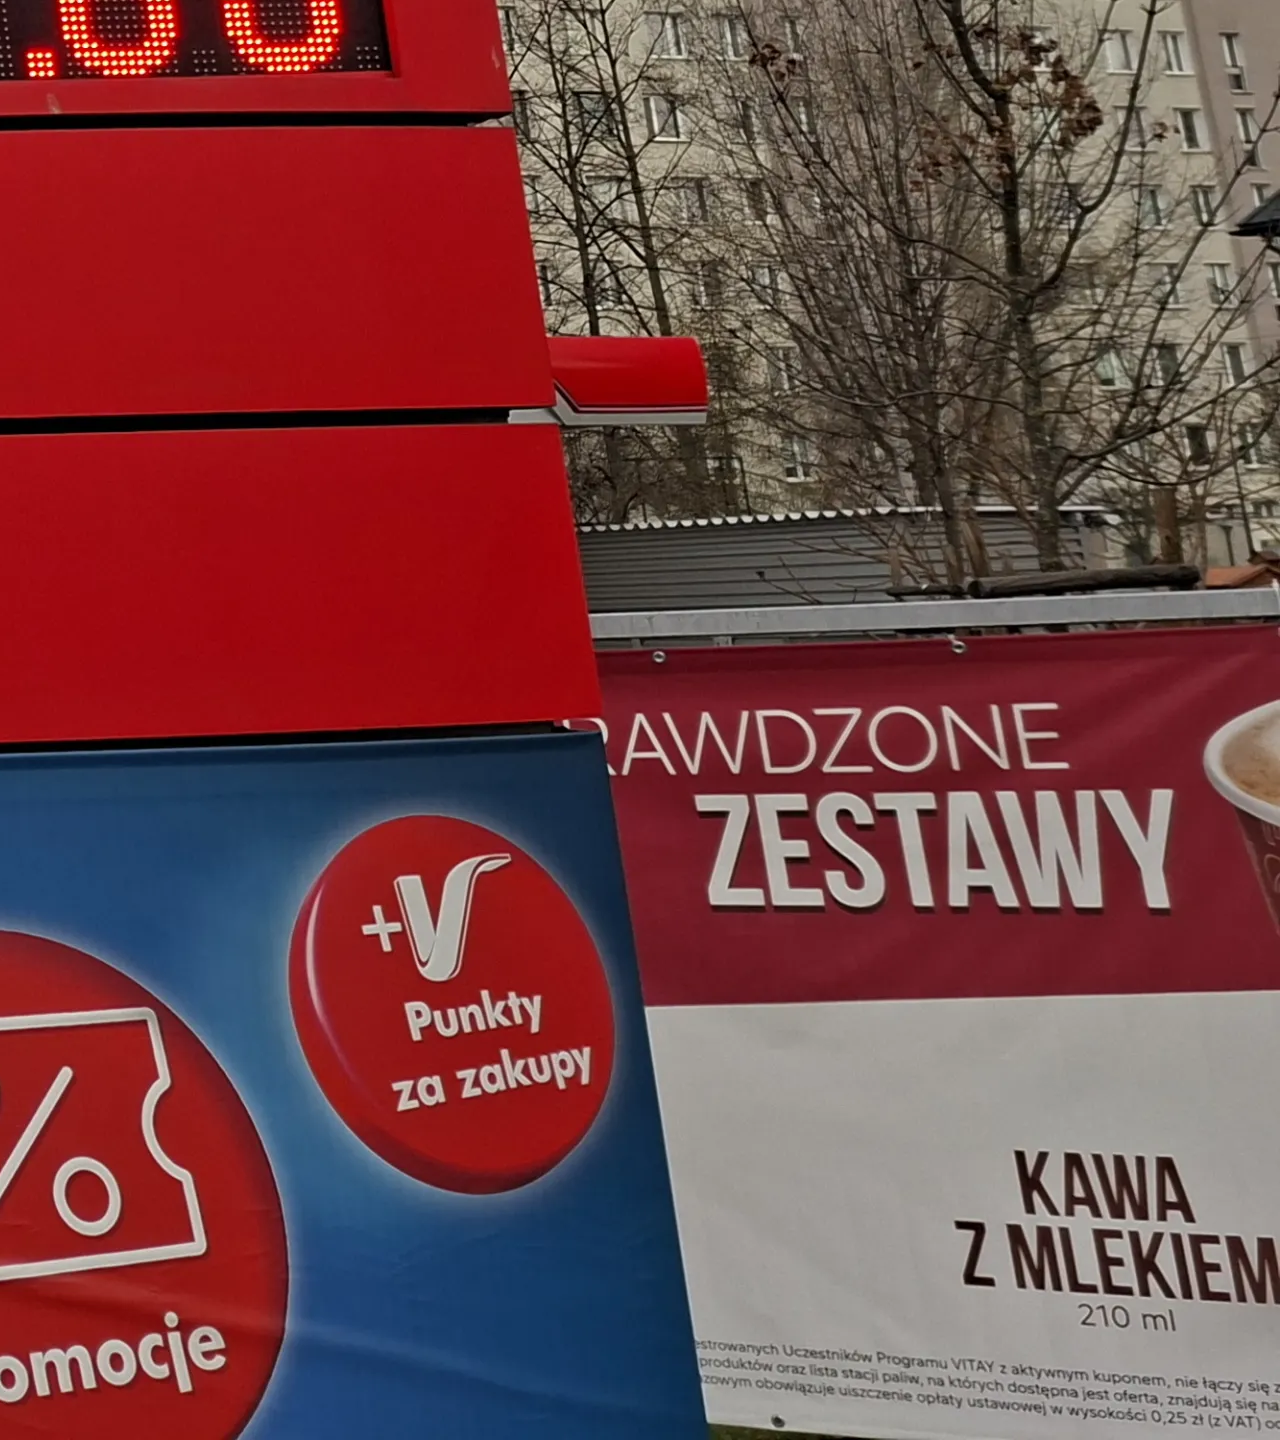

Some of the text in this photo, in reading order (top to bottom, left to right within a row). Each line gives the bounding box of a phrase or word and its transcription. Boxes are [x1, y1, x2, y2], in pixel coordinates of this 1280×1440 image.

[693, 789, 1174, 910] ZESTAWY
[404, 990, 542, 1042] Punkty
[391, 1047, 593, 1113] za zakupy
[1013, 1149, 1197, 1224] KAWA
[954, 1220, 1280, 1306] Z MLEKIEM
[1078, 1303, 1177, 1332] 210 ml
[699, 1357, 773, 1372] produktów
[776, 1363, 807, 1376] oraz
[809, 1363, 838, 1378] lista
[841, 1368, 879, 1384] stacji
[882, 1370, 924, 1387] paliw,
[927, 1376, 945, 1387] na
[948, 1375, 1004, 1393] których
[1007, 1381, 1079, 1399] dostępna
[1081, 1386, 1110, 1402] jest
[1113, 1389, 1164, 1407] oferta,
[1167, 1394, 1232, 1413] znajdują
[1235, 1396, 1257, 1414] się
[782, 1344, 873, 1363] Uczestników
[876, 1351, 948, 1370] Programu
[950, 1358, 994, 1373] VITAY
[999, 1364, 1007, 1375] z
[1011, 1364, 1089, 1383] aktywnym
[1092, 1369, 1171, 1389] kuponem,
[1175, 1375, 1198, 1389] nie
[1202, 1376, 1243, 1394] łączy
[1248, 1379, 1270, 1396] się
[755, 1377, 836, 1396] obowiązuje
[839, 1384, 912, 1402] uiszczenie
[916, 1391, 963, 1408] opłaty
[966, 1396, 1047, 1416] ustawowej
[1049, 1403, 1063, 1416] w
[1066, 1406, 1147, 1422] wysokości
[1151, 1409, 1187, 1426] 0,25
[1191, 1413, 1205, 1426] zł
[1224, 1415, 1261, 1431] VAT)
